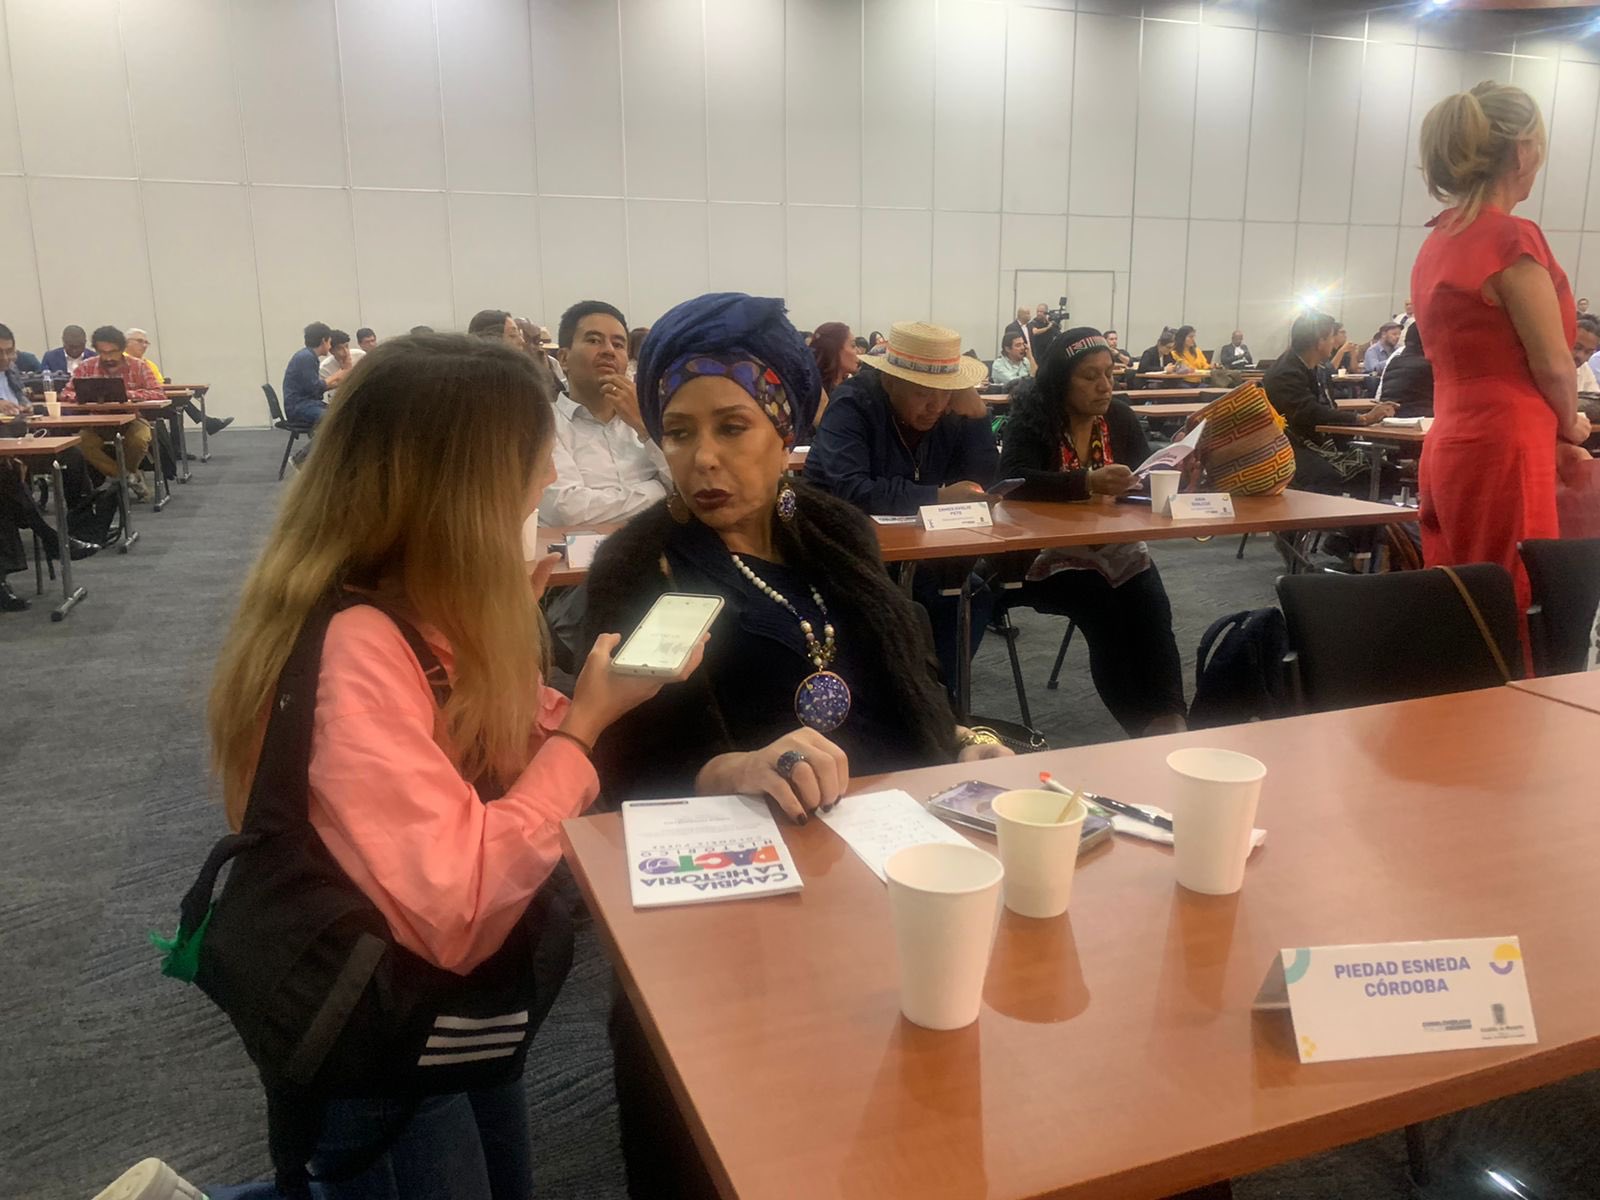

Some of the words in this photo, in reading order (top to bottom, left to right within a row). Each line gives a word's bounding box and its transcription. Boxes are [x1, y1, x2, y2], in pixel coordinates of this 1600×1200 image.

[638, 844, 781, 875] PACTO
[753, 863, 785, 874] LA
[639, 869, 750, 887] HISTORIA
[693, 872, 789, 891] CAMBIA
[1334, 960, 1399, 979] PIEDAD
[1402, 956, 1471, 975] ESNEDA
[1364, 978, 1449, 998] CÓRDOBA
